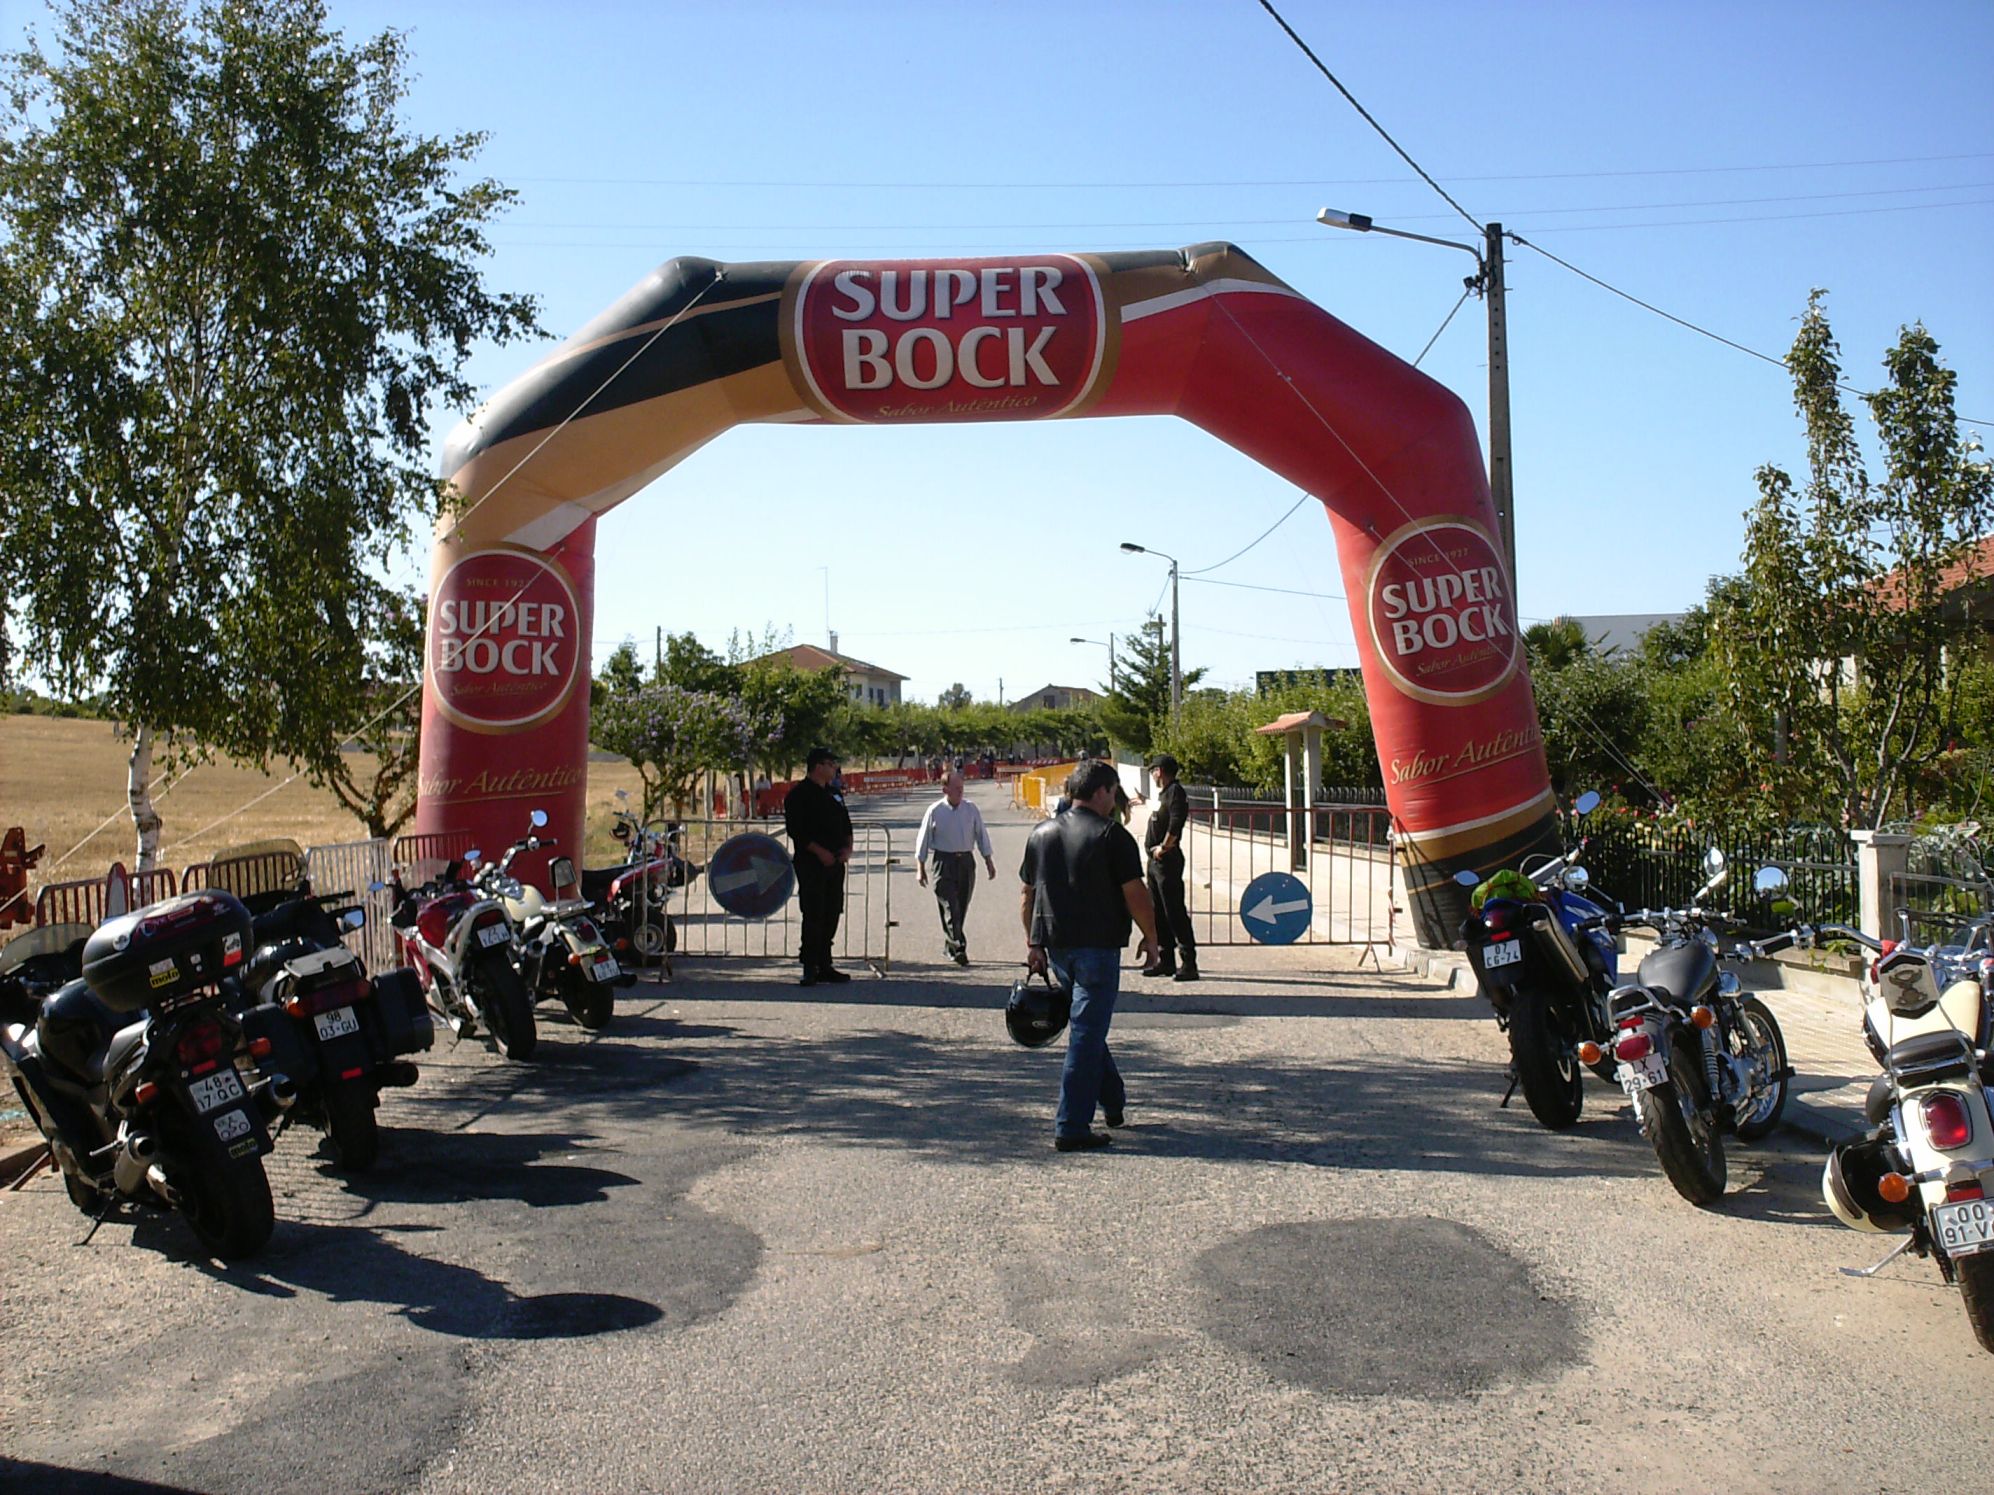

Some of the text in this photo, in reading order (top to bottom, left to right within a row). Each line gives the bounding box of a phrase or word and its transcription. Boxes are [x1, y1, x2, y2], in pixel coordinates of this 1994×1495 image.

[831, 266, 1067, 321] SUPER
[841, 326, 1061, 390] BOCK
[1382, 566, 1503, 619] SUPER
[439, 600, 565, 638] SUPER
[1392, 603, 1508, 656] BOCK
[439, 638, 560, 676] BOCK
[1391, 750, 1449, 785] Sabor
[1494, 943, 1507, 955] 07
